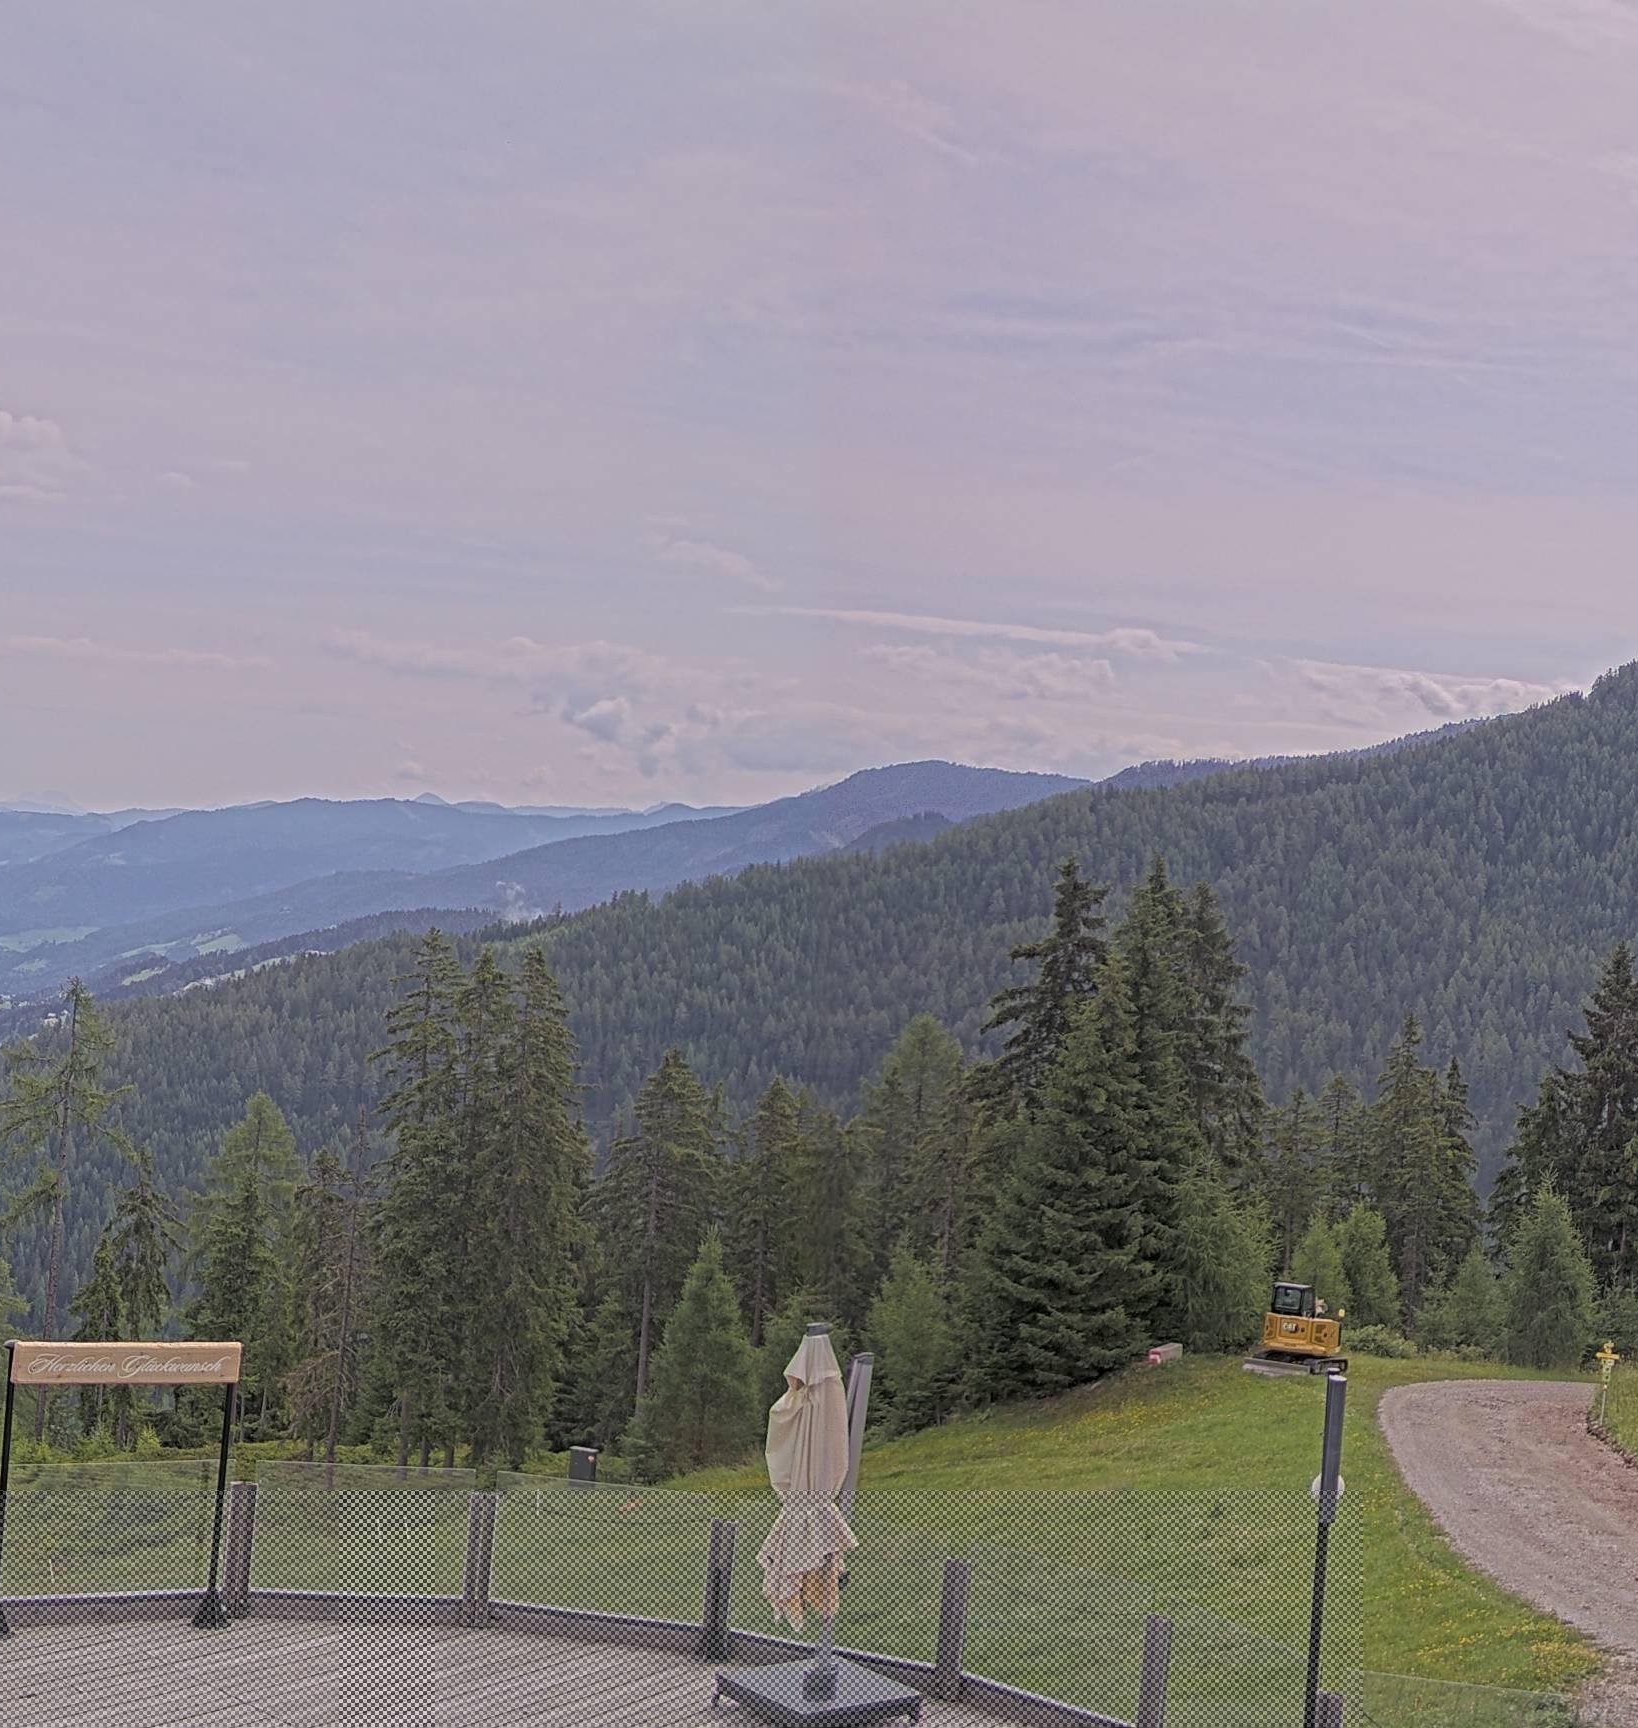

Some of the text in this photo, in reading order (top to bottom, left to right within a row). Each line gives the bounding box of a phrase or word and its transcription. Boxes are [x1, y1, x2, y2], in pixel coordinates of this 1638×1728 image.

[1283, 1322, 1296, 1332] CAT
[28, 1353, 231, 1378] Herzlichen Glückwunsch
